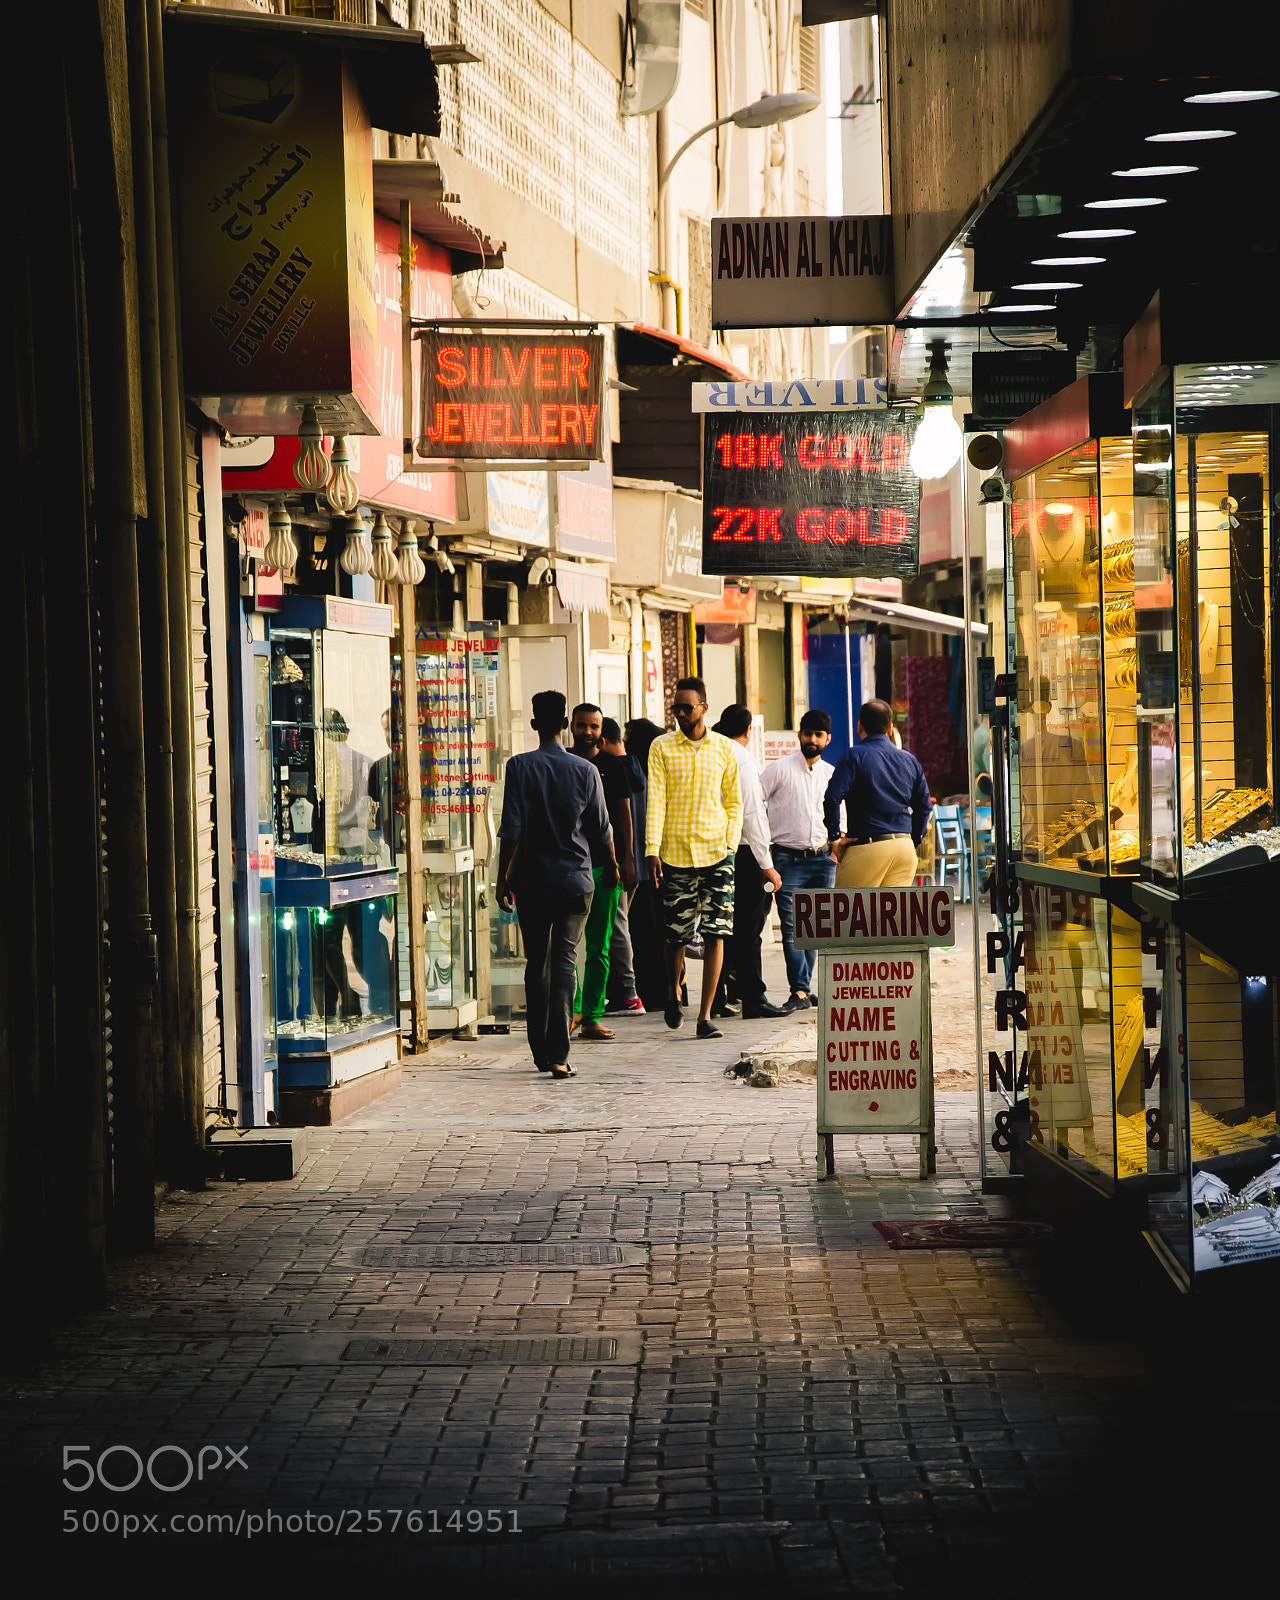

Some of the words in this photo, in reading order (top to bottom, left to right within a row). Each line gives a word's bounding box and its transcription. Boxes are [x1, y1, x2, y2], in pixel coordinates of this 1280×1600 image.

[207, 165, 257, 213] مجوهرات
[220, 143, 312, 241] السراج
[717, 222, 790, 279] ADNAN
[796, 221, 823, 277] AL
[209, 304, 240, 338] AL
[228, 237, 282, 307] SERAJ
[229, 246, 313, 366] JEWELLERY
[272, 325, 297, 354] BOX
[436, 346, 591, 388] SILVER
[427, 402, 599, 444] JEWELLERY
[717, 433, 784, 468] 18K
[799, 434, 908, 470] GOLD
[712, 507, 782, 541] 22K
[797, 508, 907, 543] GOLD
[421, 640, 448, 652] TYPE
[451, 639, 499, 652] JEWELRY
[434, 773, 461, 782] Stone
[794, 890, 952, 938] REPAIRING
[832, 961, 915, 982] DIAMOND
[832, 985, 914, 1001] JEWELLERY
[830, 1006, 897, 1032] NAME
[826, 1041, 901, 1063] CUTTING
[909, 1039, 921, 1061] &
[829, 1069, 918, 1091] ENGRAVING
